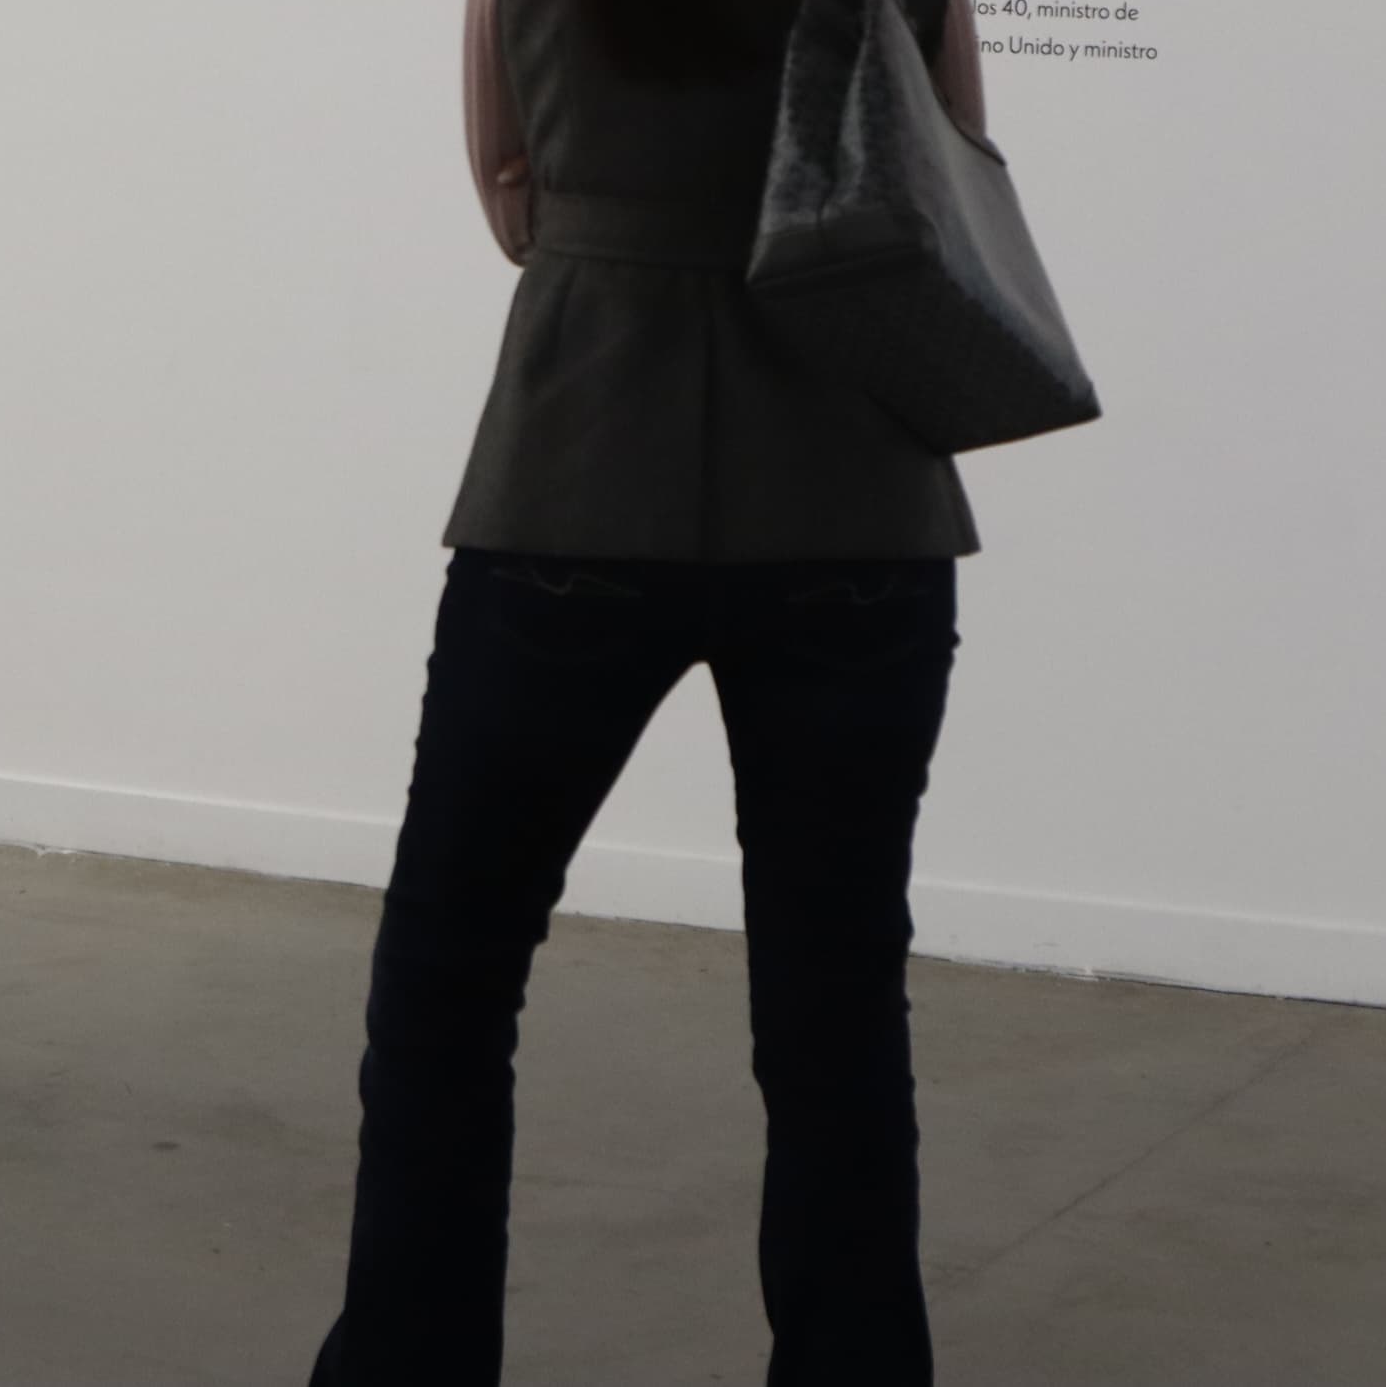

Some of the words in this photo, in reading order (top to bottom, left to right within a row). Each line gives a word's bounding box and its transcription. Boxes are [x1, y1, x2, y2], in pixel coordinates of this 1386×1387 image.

[1036, 0, 1110, 20] ministro
[1114, 1, 1139, 21] de
[1008, 35, 1065, 56] Unido
[1068, 44, 1080, 61] y
[1084, 40, 1158, 60] ministro
